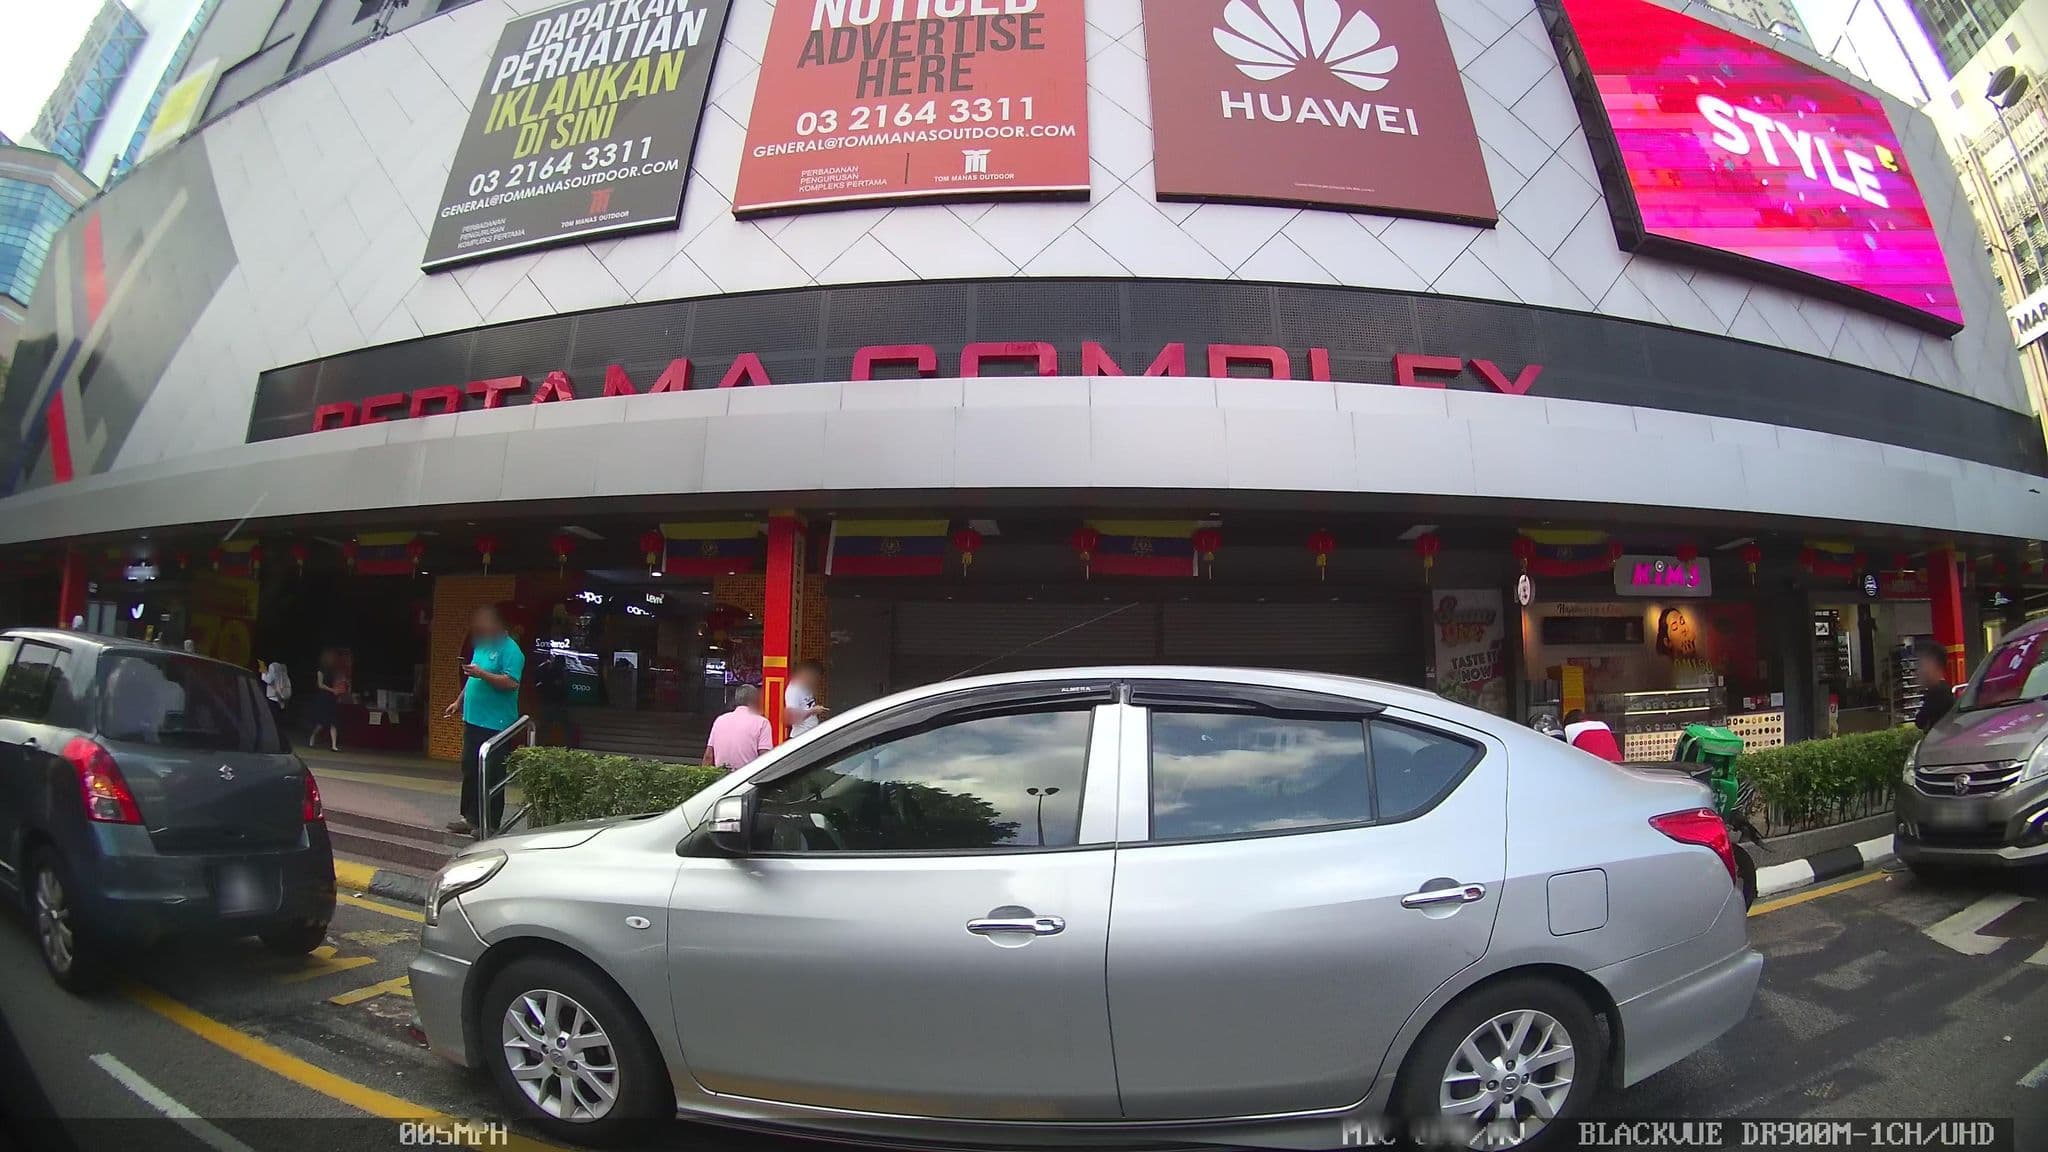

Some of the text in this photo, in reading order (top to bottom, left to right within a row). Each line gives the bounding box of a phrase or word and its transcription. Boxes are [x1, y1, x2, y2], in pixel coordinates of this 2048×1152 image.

[491, 8, 707, 95] PERHATIAN
[797, 13, 1045, 69] ADVERTISE
[484, 50, 685, 134] IKLANKAN
[856, 52, 976, 99] HERE
[513, 102, 619, 160] DI SINI
[796, 96, 1033, 136] 03 2164 3311
[1220, 90, 1419, 136] HUAWEI
[752, 124, 1076, 158] GENERAL@TOMMANASOUTDOOR.COM
[1696, 94, 1889, 208] STYLE
[441, 158, 679, 218] GENERAL@TOMMANASOUTDOOR.COM
[468, 136, 652, 197] 03 2164 3311
[799, 178, 888, 192] KOMPLEKS PERTAMA
[800, 174, 859, 185] PENGURUSAN
[801, 166, 859, 178] PERBADANAN
[934, 172, 1015, 183] TOM MANAS OUTDOOR
[1451, 652, 1486, 670] TASTE
[1461, 665, 1493, 682] NOW
